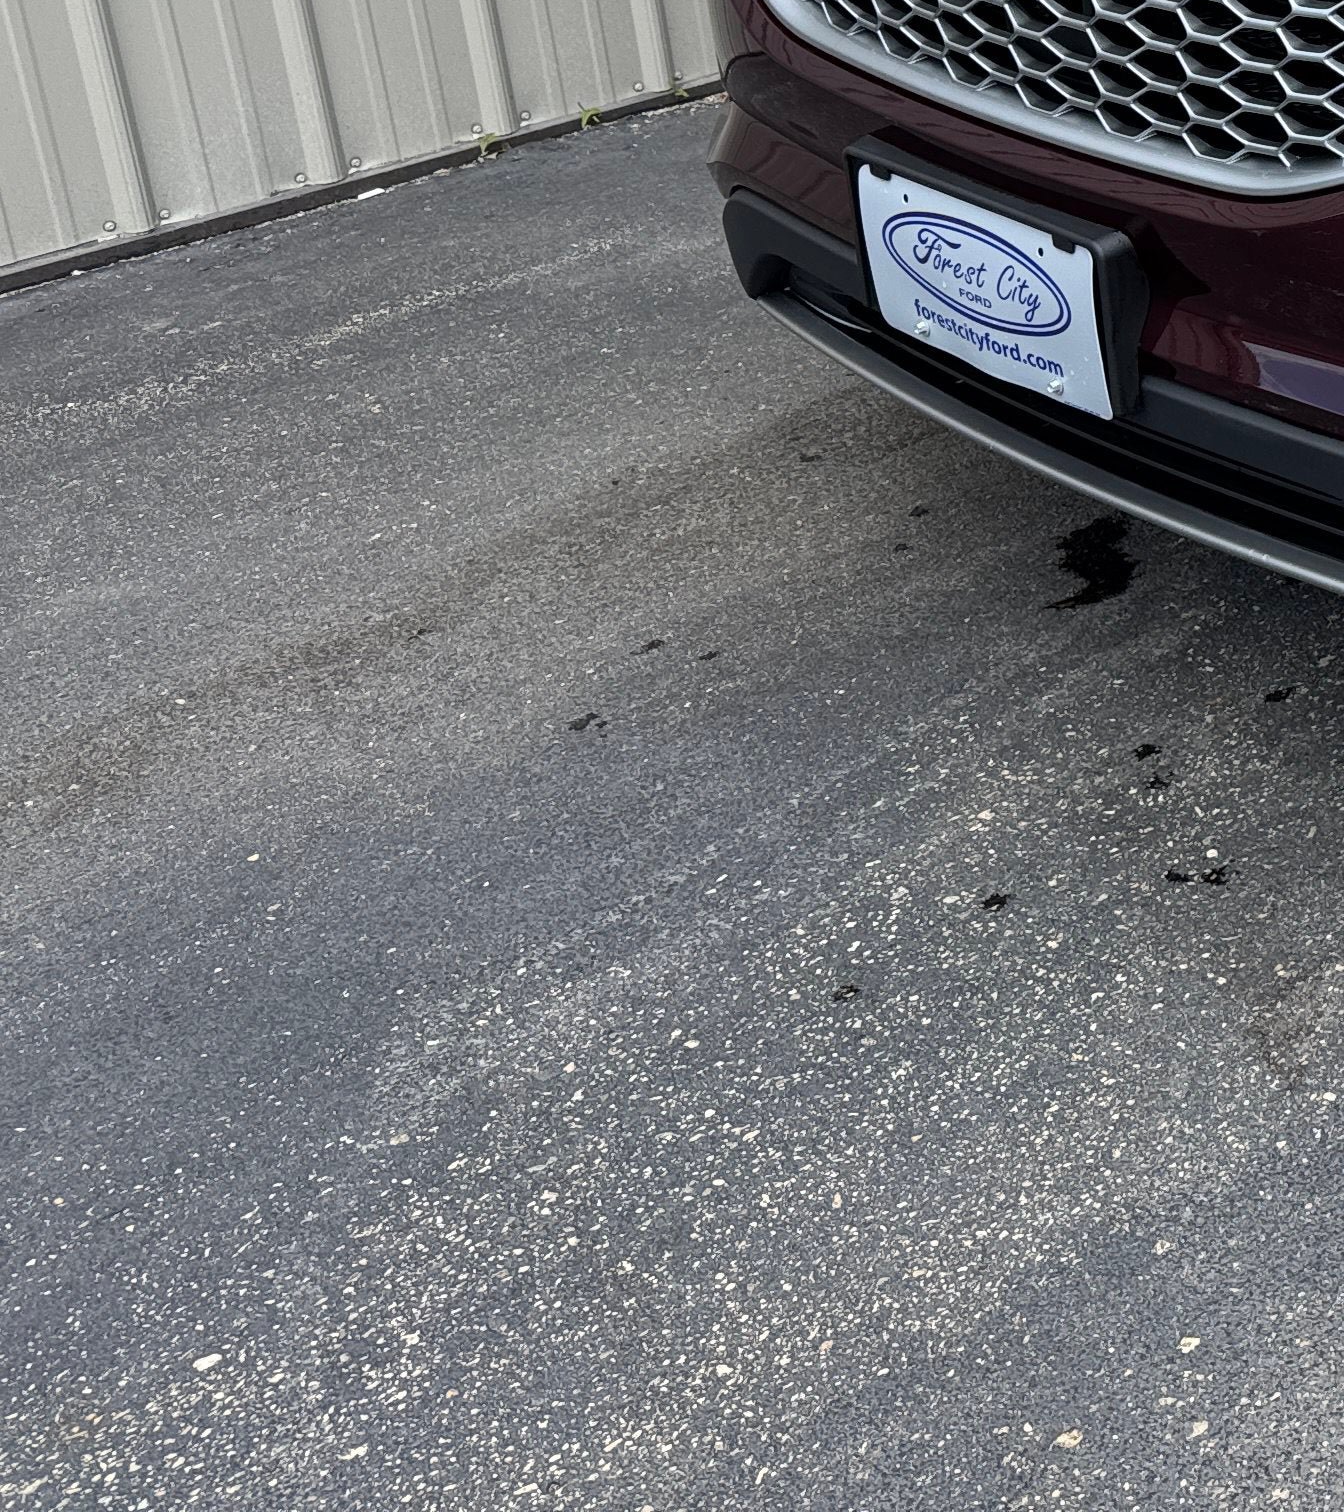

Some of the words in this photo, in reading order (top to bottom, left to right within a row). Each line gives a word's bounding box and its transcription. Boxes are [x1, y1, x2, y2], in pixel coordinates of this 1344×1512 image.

[912, 227, 987, 288] Forest
[996, 265, 1042, 323] City
[959, 288, 993, 309] FORD
[914, 299, 1065, 378] forestcityford.com
